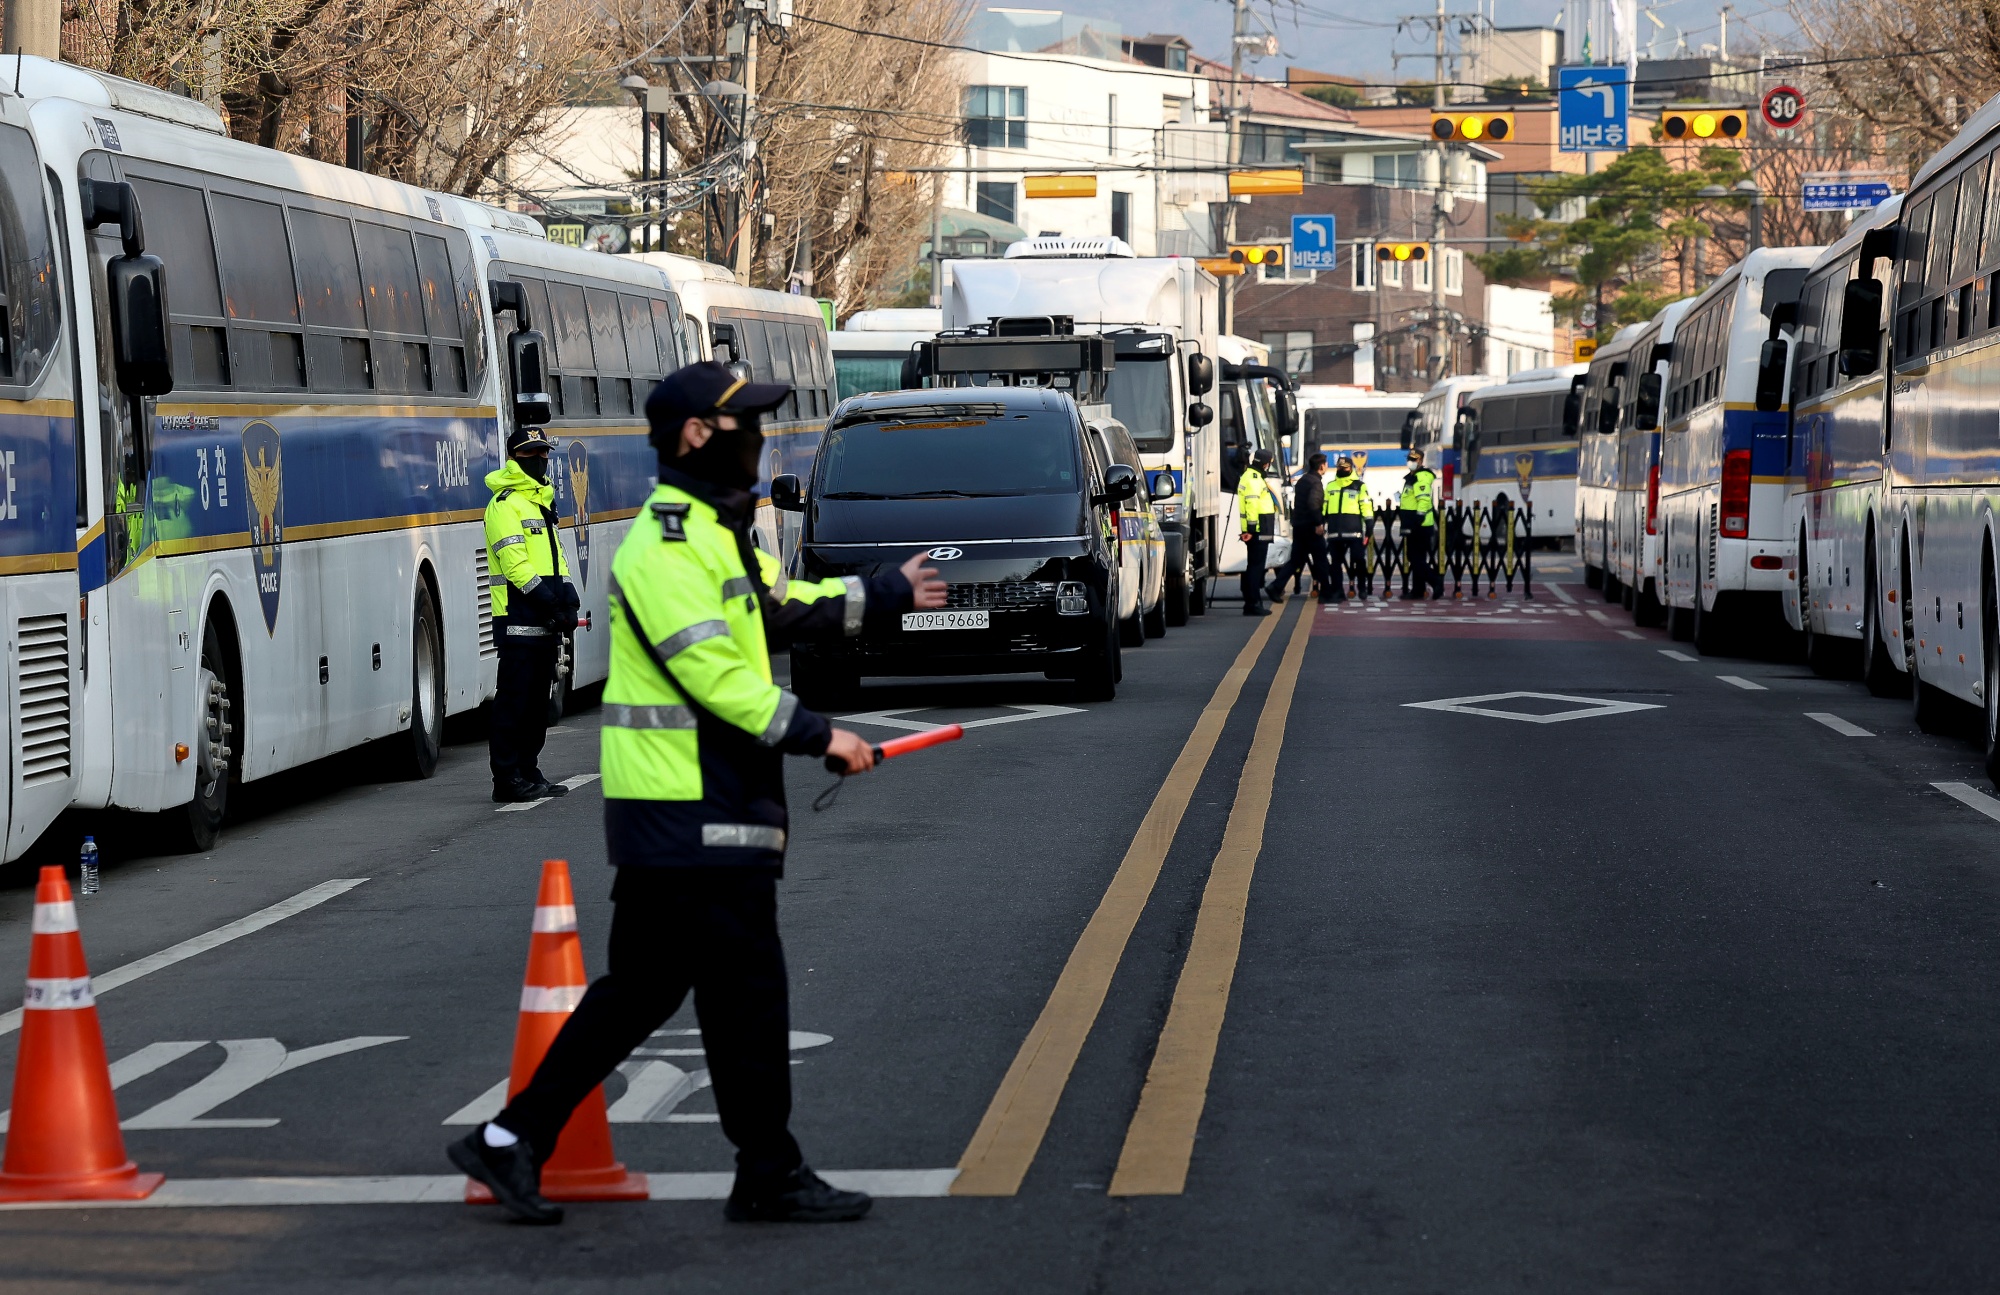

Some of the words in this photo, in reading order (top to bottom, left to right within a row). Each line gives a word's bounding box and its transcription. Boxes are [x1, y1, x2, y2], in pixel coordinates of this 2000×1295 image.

[1770, 96, 1797, 119] 30
[1561, 123, 1624, 150] 비보호
[1293, 250, 1333, 267] 비보호
[436, 440, 469, 487] POLICE
[196, 445, 229, 511] 경찰
[260, 572, 278, 593] POLICE
[907, 614, 944, 628] 709더
[947, 612, 984, 627] 9668
